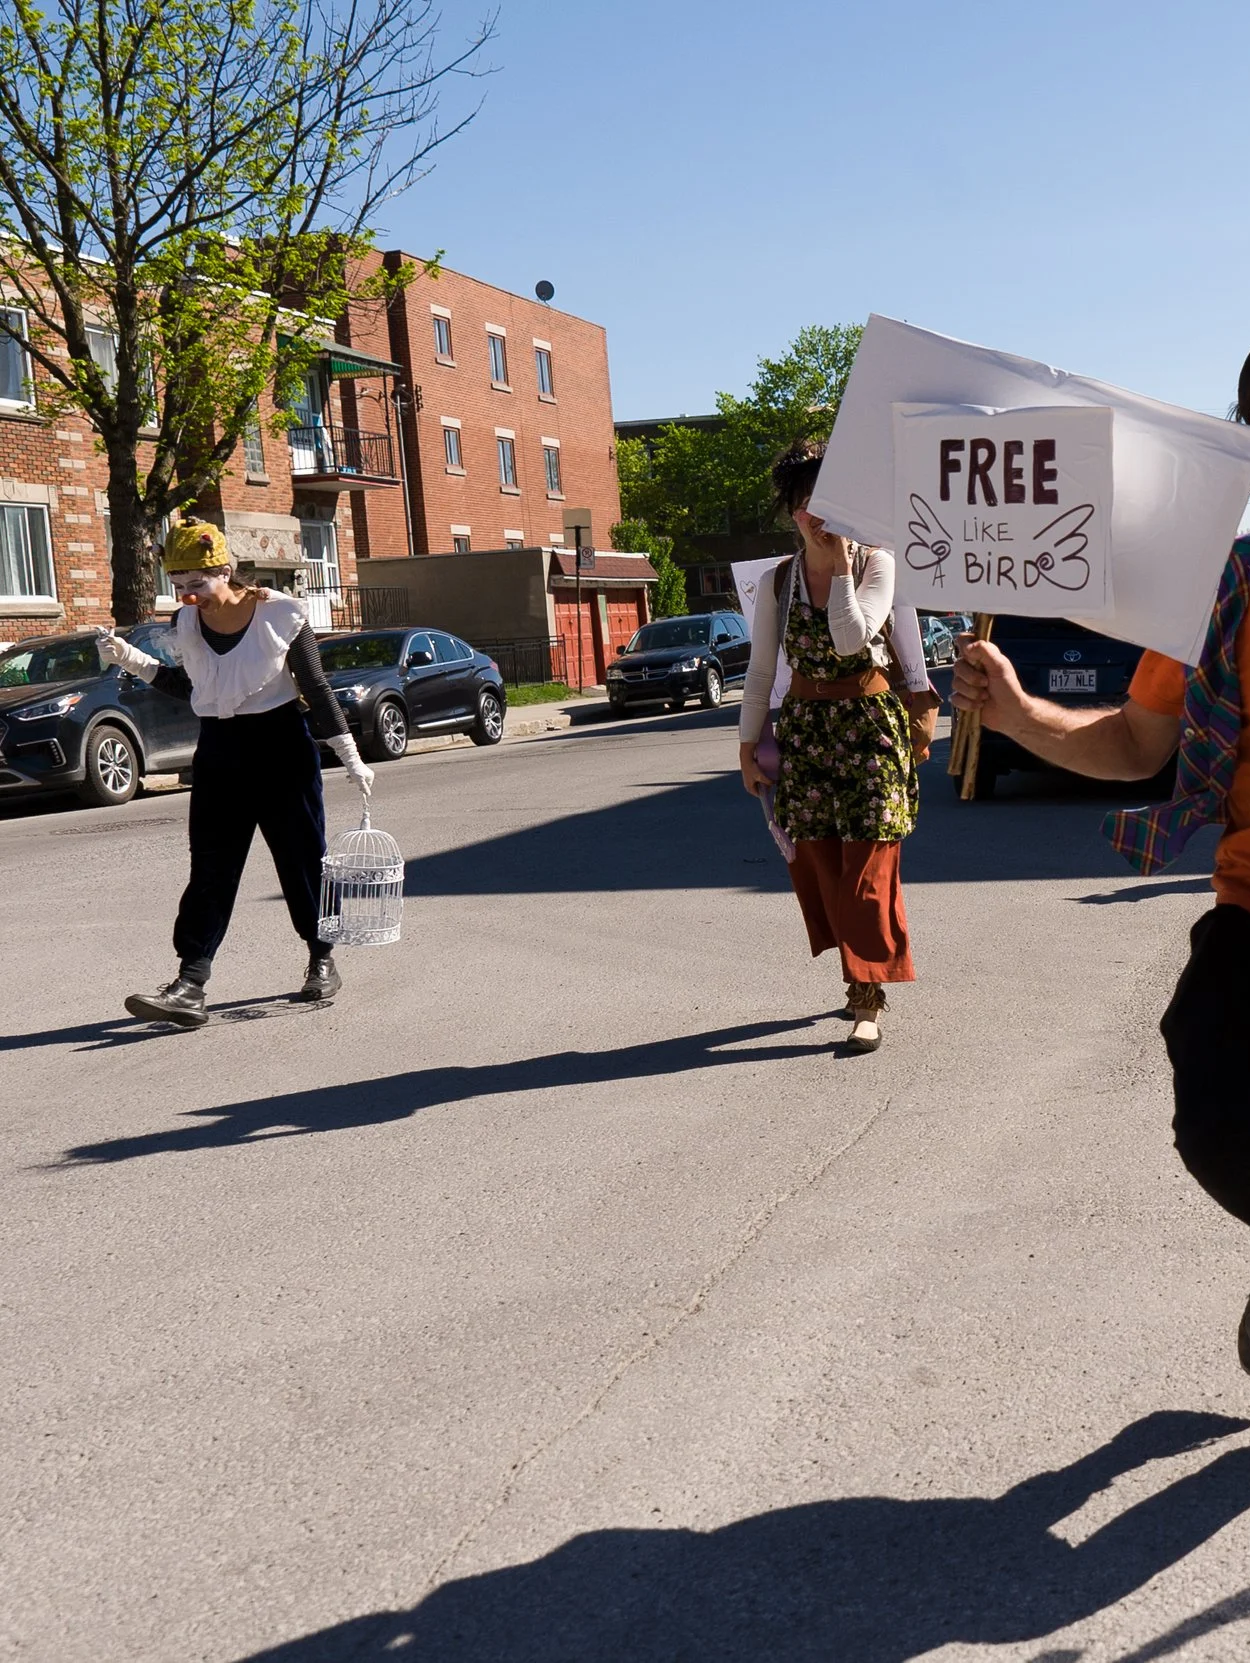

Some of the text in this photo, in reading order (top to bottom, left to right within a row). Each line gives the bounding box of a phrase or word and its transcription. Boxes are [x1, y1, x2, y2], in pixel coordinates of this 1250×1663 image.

[939, 438, 1059, 507] FREE
[932, 557, 946, 589] A
[1051, 674, 1095, 687] H17 NLE
